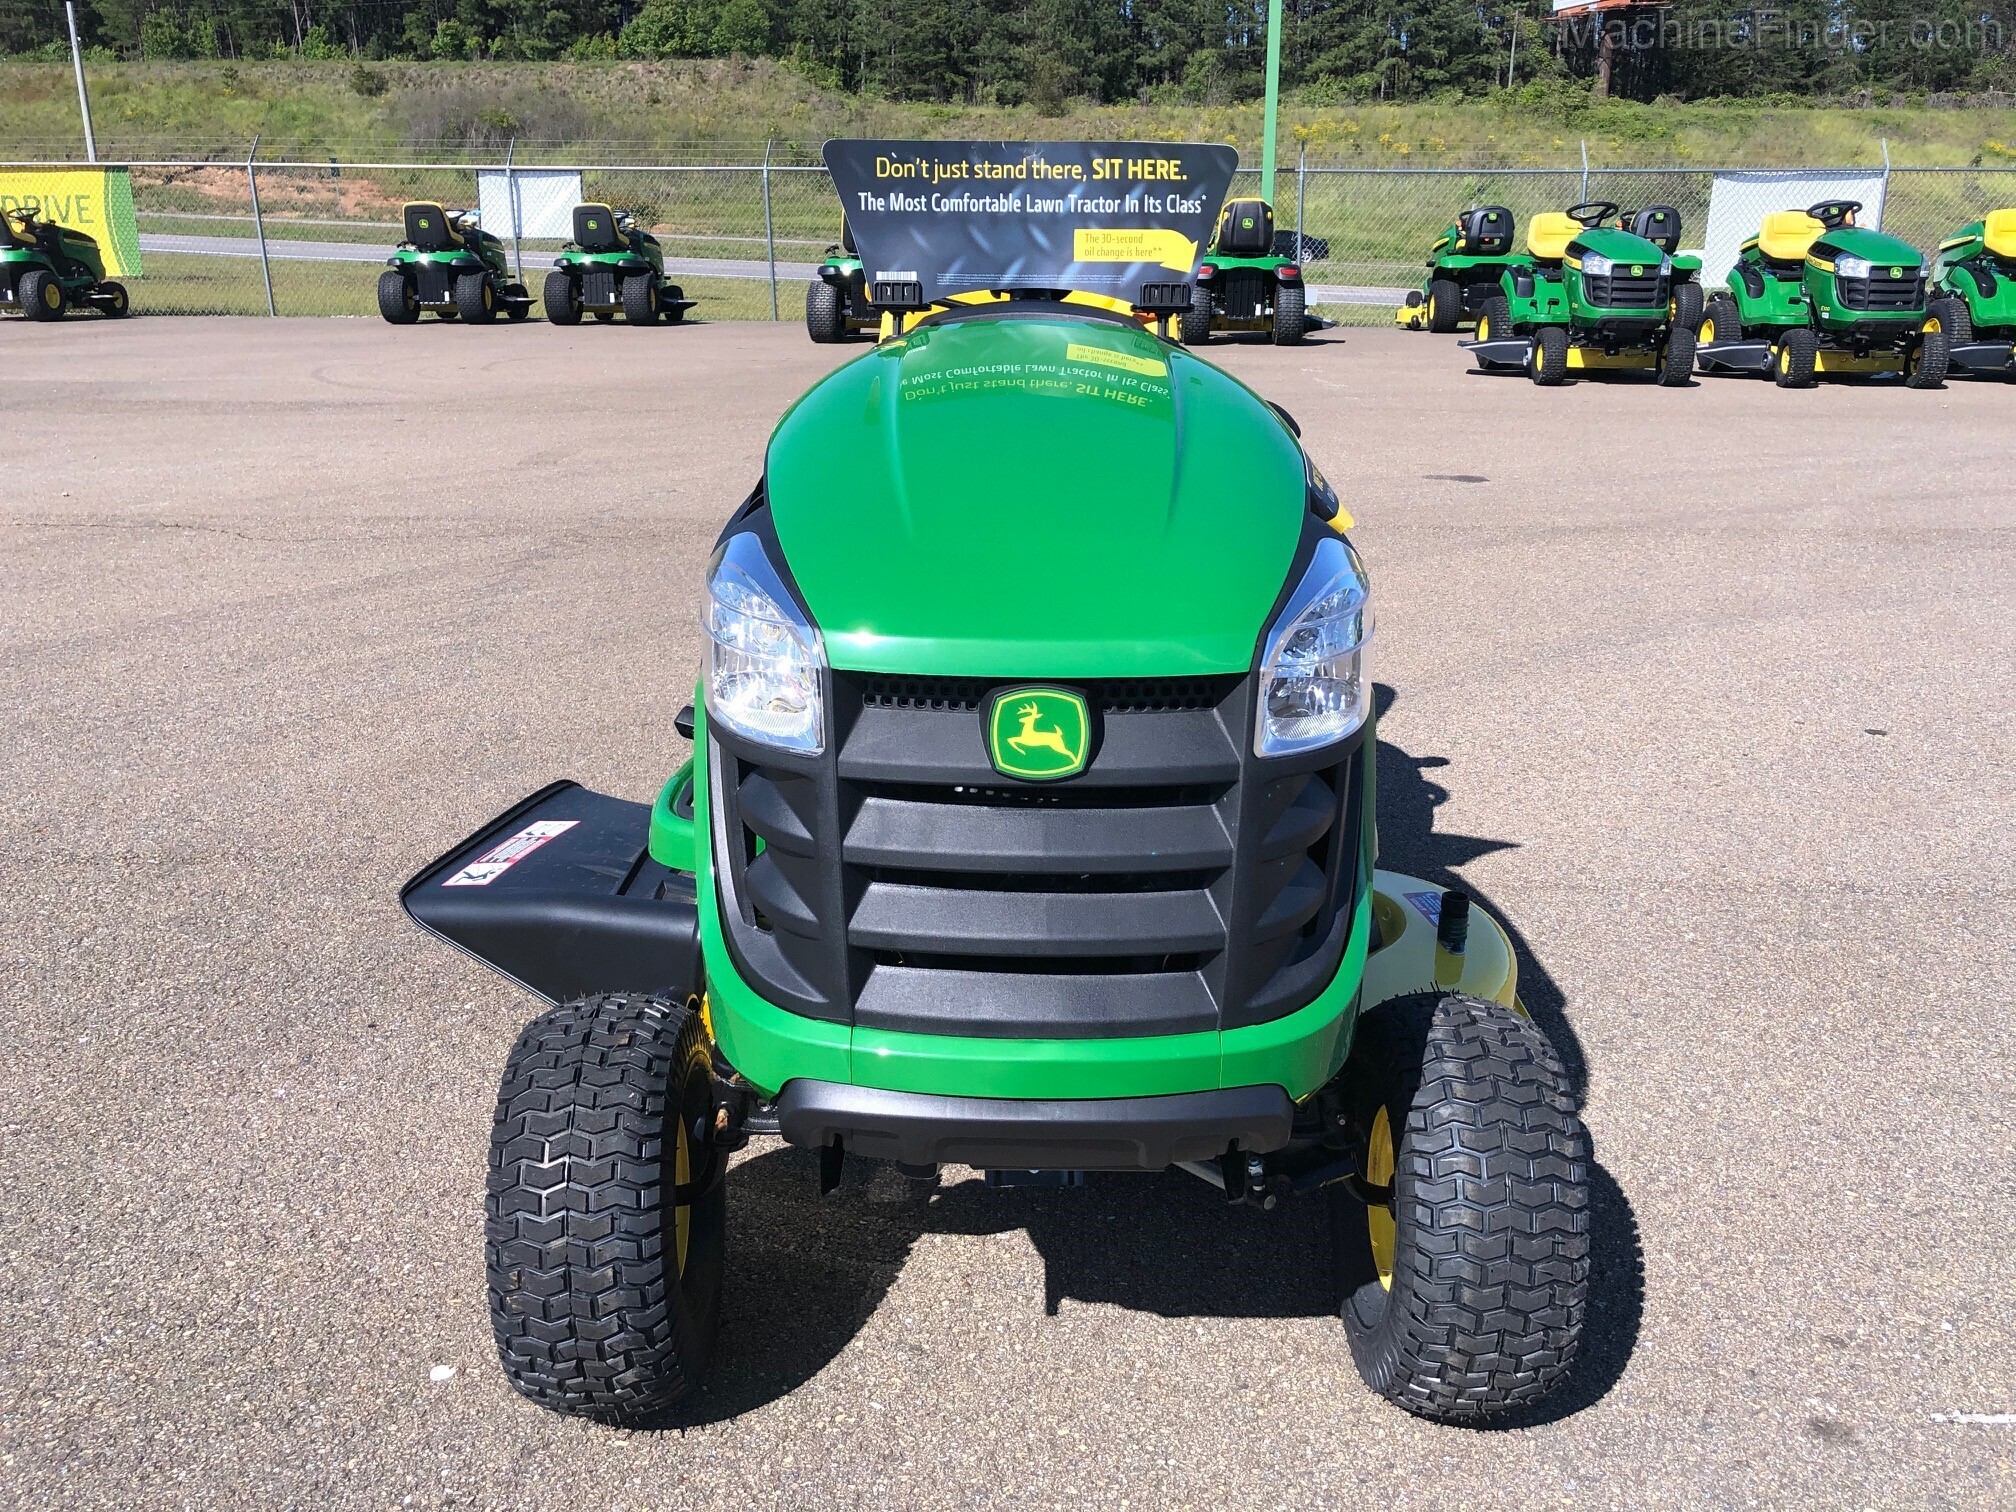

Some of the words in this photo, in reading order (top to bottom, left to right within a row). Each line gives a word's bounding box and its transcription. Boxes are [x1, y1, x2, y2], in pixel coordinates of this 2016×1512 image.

[875, 157, 930, 178] Don't
[932, 158, 970, 184] just
[974, 157, 1027, 179] stand
[1031, 158, 1087, 182] there,
[1092, 158, 1123, 180] SIT
[1127, 158, 1188, 181] HERE.
[858, 192, 885, 212] The
[889, 192, 928, 212] Most
[931, 192, 1022, 213] Comfortable
[1026, 193, 1064, 214] Lawn
[1067, 193, 1121, 214] Tractor
[1125, 193, 1140, 214] In
[1144, 193, 1162, 214] Its
[1084, 233, 1100, 244] The
[1101, 233, 1144, 244] 30-second
[1084, 247, 1095, 257] oil
[1096, 247, 1125, 259] change
[1126, 247, 1133, 257] is
